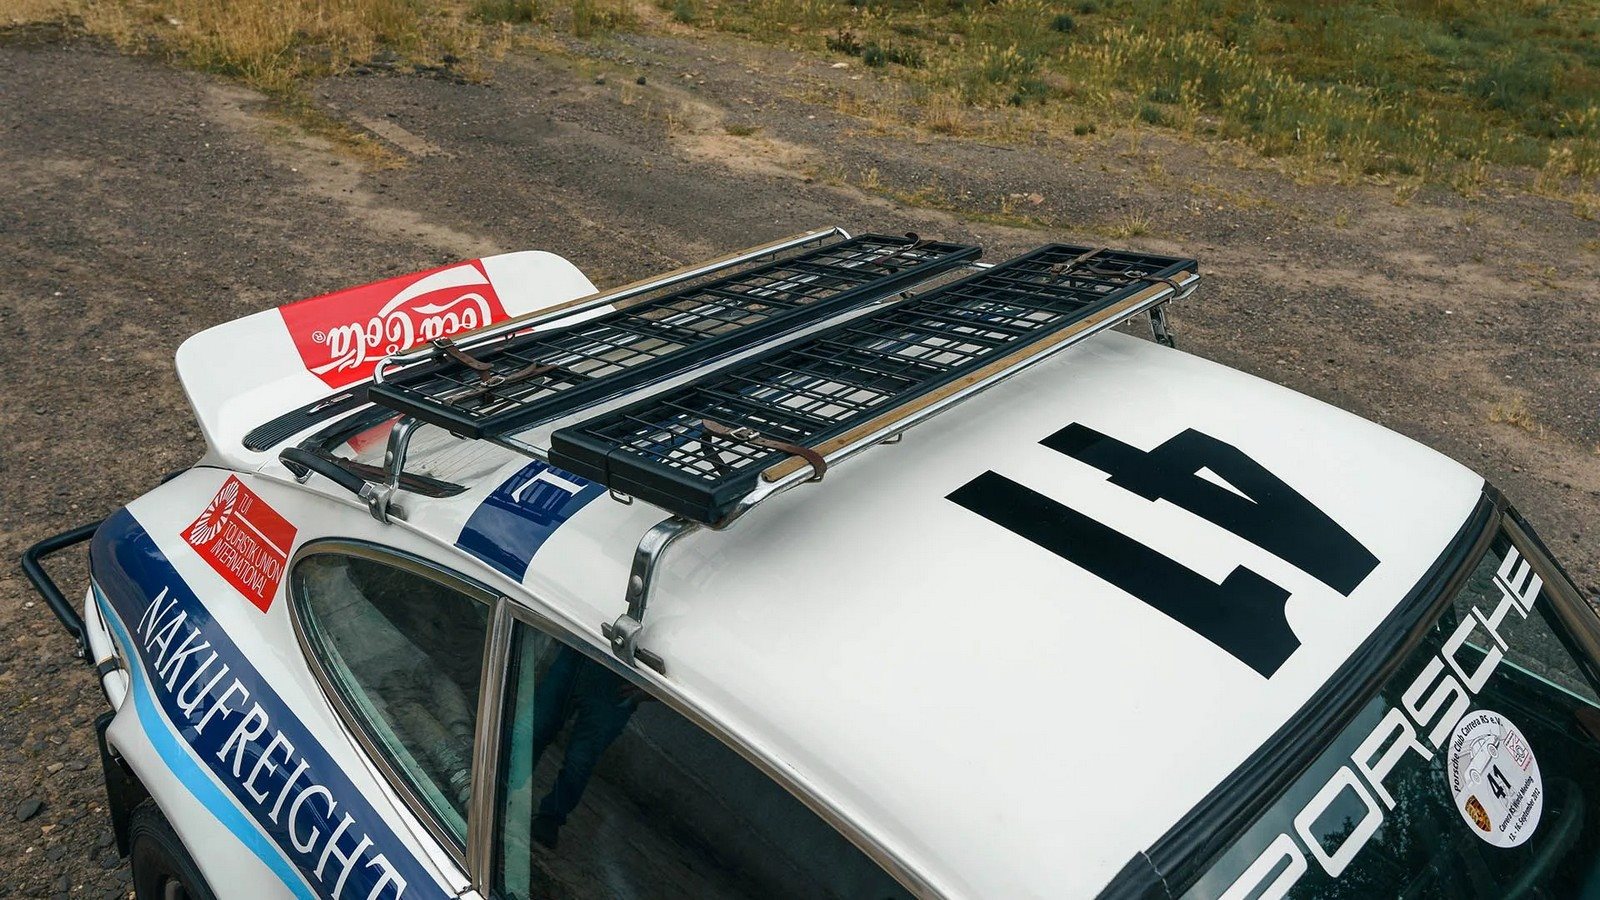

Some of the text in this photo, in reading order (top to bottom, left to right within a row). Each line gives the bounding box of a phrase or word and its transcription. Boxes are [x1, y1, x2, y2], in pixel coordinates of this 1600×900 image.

[238, 493, 253, 515] TUI
[210, 538, 268, 598] INTERNATIONAL
[223, 520, 284, 583] TOURISTIK UNION
[944, 421, 1381, 681] 41
[1216, 544, 1544, 900] PORSCHE
[1461, 718, 1481, 735] Carrera
[1480, 714, 1490, 724] RS
[136, 585, 407, 900] NAKUFREIGHT
[1454, 734, 1465, 752] Club
[1453, 752, 1462, 793] Porsche
[1487, 764, 1512, 799] 41
[1499, 813, 1512, 832] Carrera
[1512, 792, 1523, 808] World
[1520, 776, 1534, 795] Meeting
[1518, 799, 1535, 825] September
[1531, 787, 1540, 801] 2012
